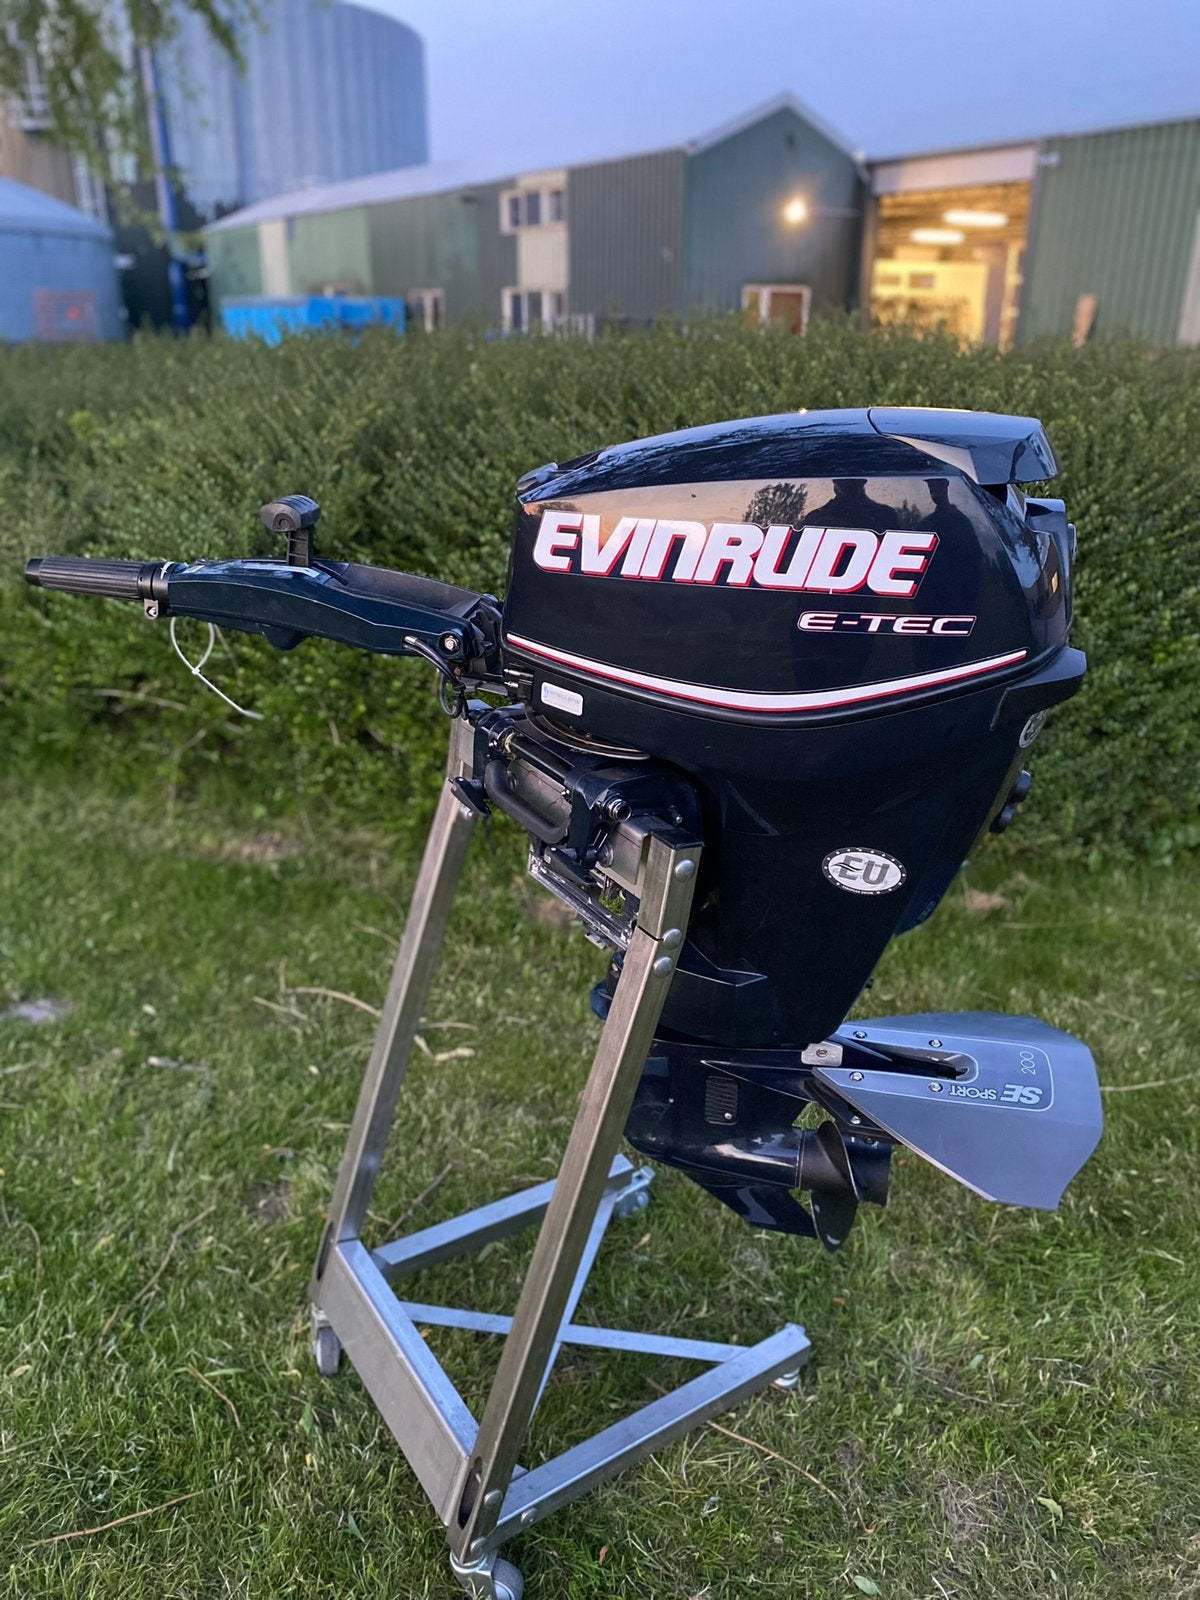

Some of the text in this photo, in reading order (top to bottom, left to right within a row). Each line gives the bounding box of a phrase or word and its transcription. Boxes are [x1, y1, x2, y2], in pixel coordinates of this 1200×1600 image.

[533, 510, 939, 598] EVINRUDE
[800, 613, 974, 634] E-TEC
[838, 855, 890, 885] EU
[1019, 1051, 1036, 1076] 200
[949, 1084, 1043, 1105] SE SPORT
